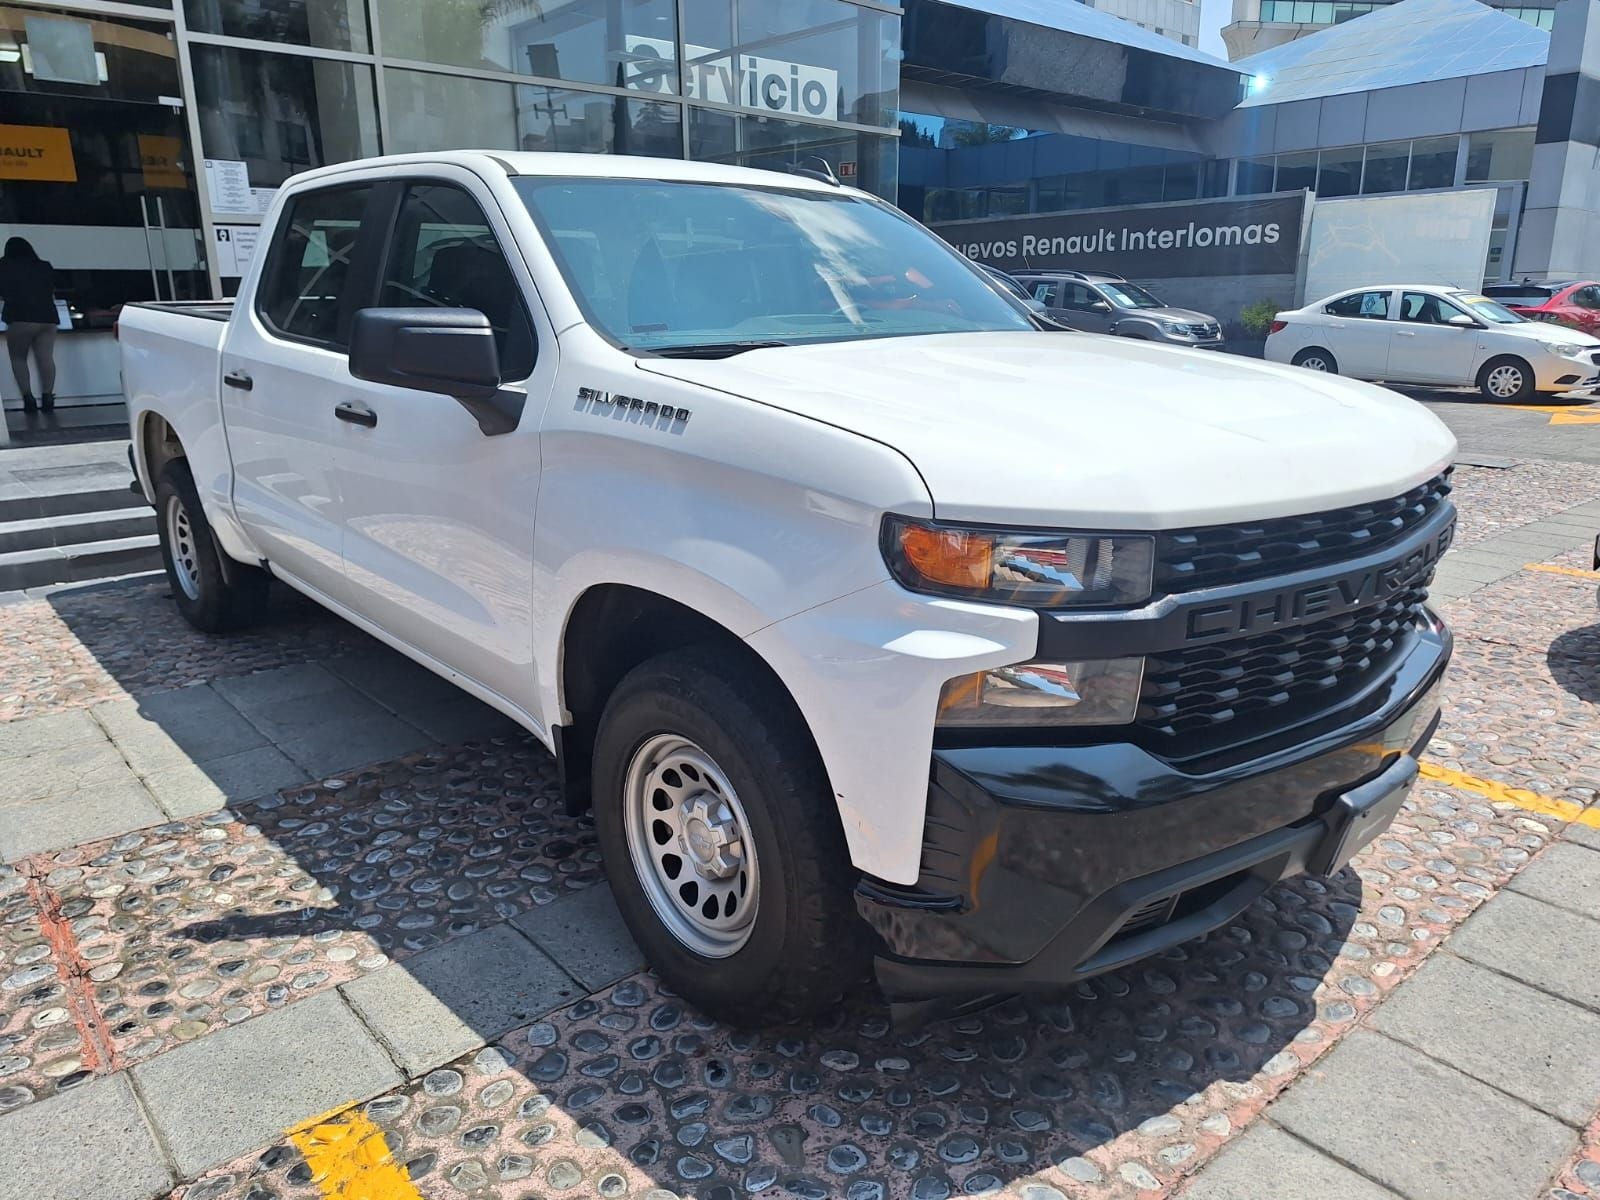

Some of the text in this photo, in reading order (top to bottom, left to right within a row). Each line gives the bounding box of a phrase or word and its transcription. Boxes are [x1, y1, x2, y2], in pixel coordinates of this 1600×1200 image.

[628, 43, 827, 116] Servicio
[1022, 228, 1116, 256] Renault
[1121, 222, 1280, 251] Interlomas
[577, 386, 692, 422] SILVERADO
